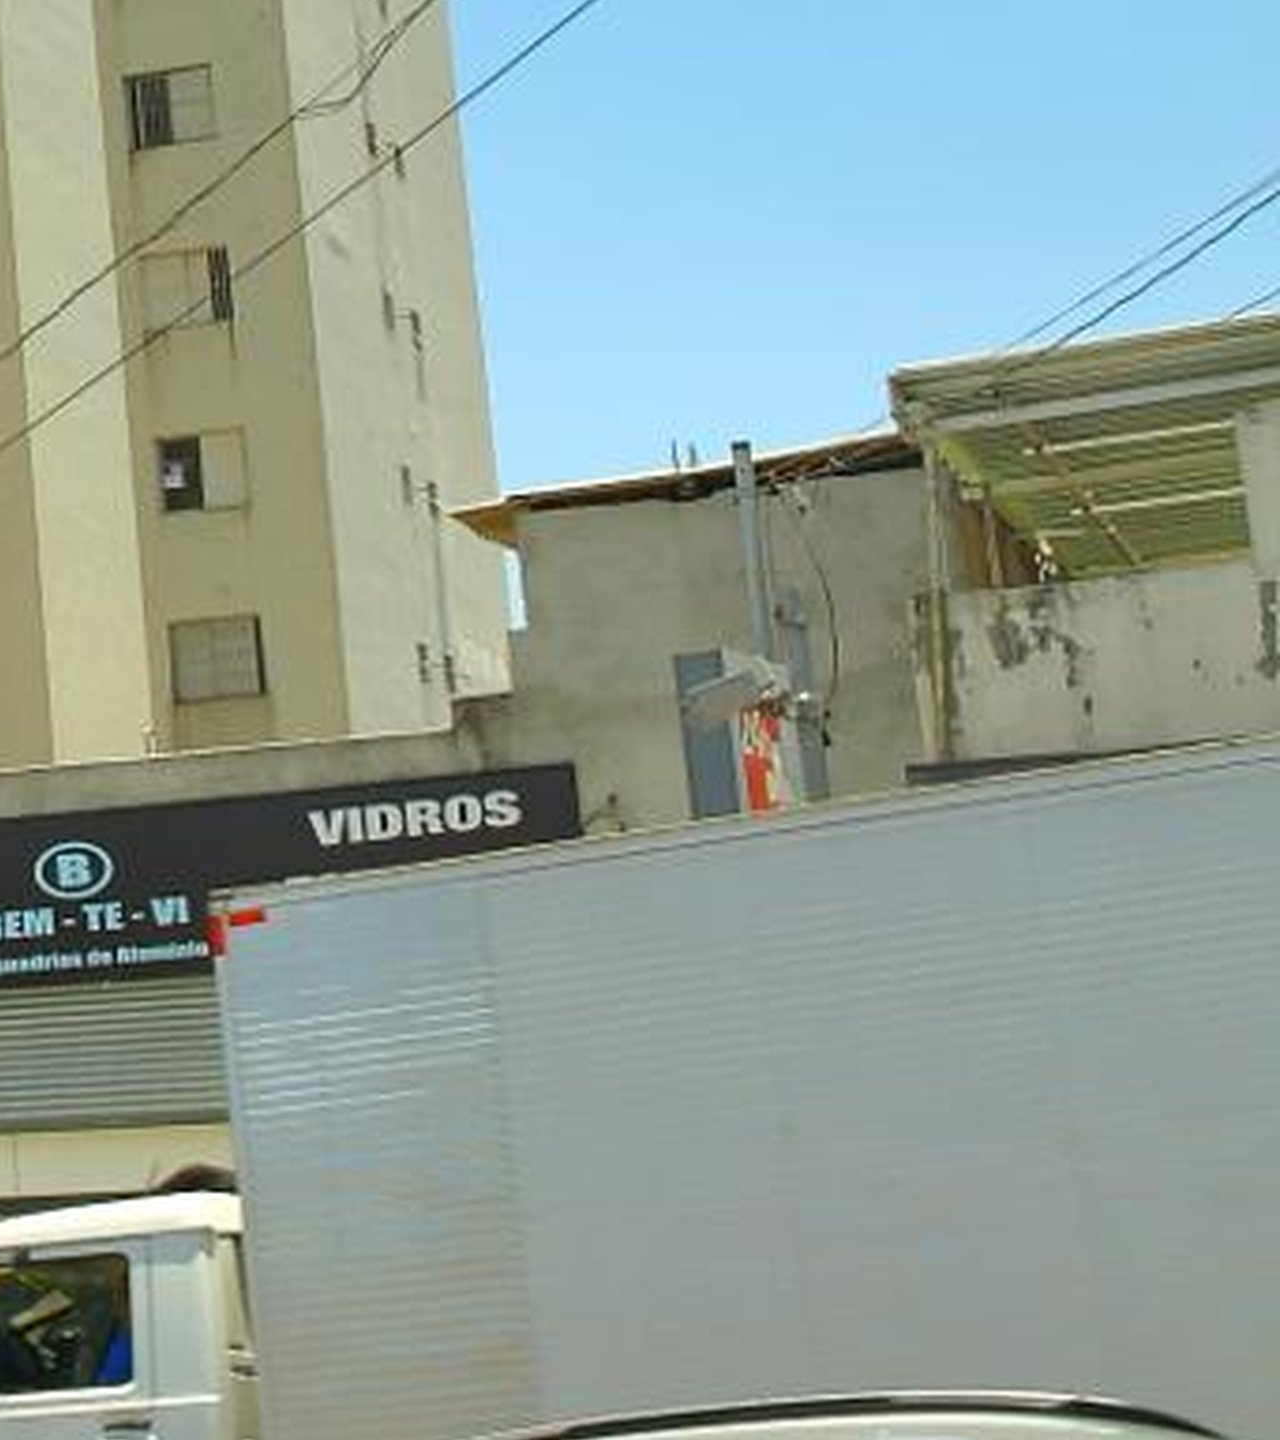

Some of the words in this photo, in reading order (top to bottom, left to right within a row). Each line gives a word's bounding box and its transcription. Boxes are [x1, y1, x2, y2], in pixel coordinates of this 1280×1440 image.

[307, 790, 522, 847] VIDROS
[81, 901, 126, 932] TE
[150, 896, 190, 926] VI
